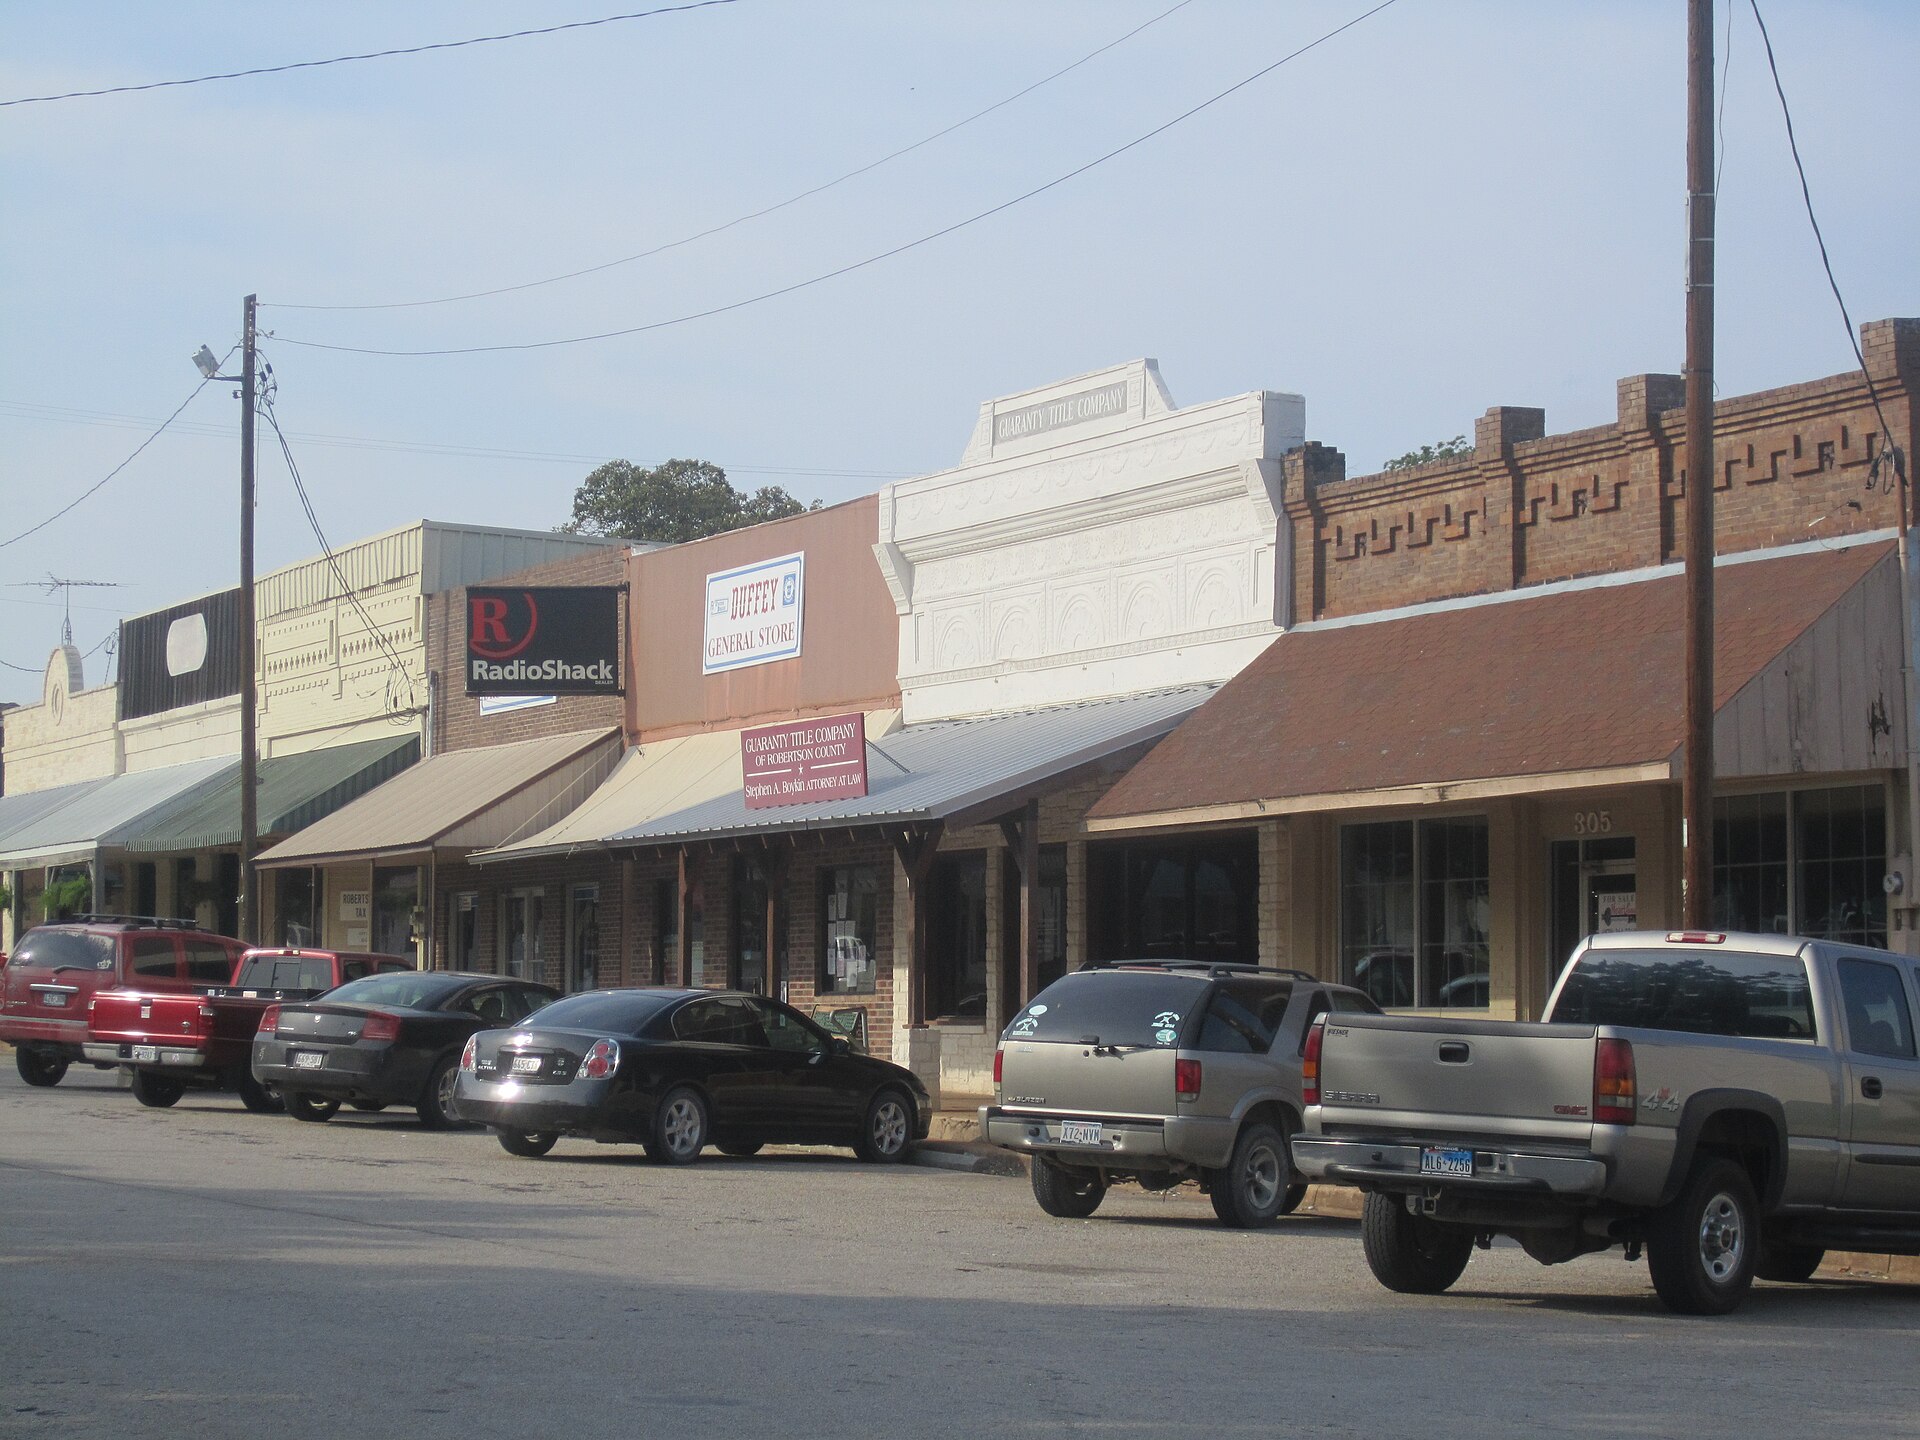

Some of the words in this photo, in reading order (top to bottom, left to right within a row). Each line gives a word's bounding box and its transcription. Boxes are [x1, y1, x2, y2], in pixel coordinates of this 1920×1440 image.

[999, 409, 1045, 438] GUARANTY
[1048, 401, 1074, 425] TITLE
[1077, 388, 1124, 417] COMPANY
[730, 577, 779, 621] DUFFEY
[707, 630, 755, 657] GENERAL
[758, 621, 795, 647] STORE
[472, 660, 613, 680] RadioShack
[745, 733, 789, 753] GUARANTY
[790, 729, 813, 747] TITLE
[815, 723, 856, 744] COMPANY
[755, 754, 766, 767] OF
[767, 748, 813, 765] ROBERTSON
[814, 743, 846, 759] COUNTY
[745, 783, 772, 799] Stephen
[773, 782, 781, 794] A.
[782, 778, 805, 796] Boykin
[806, 776, 838, 791] ATTORNEY
[838, 775, 847, 786] AT
[847, 773, 862, 785] LAW
[1574, 811, 1611, 834] 305
[343, 894, 368, 904] ROBERTS
[356, 908, 366, 918] TAX
